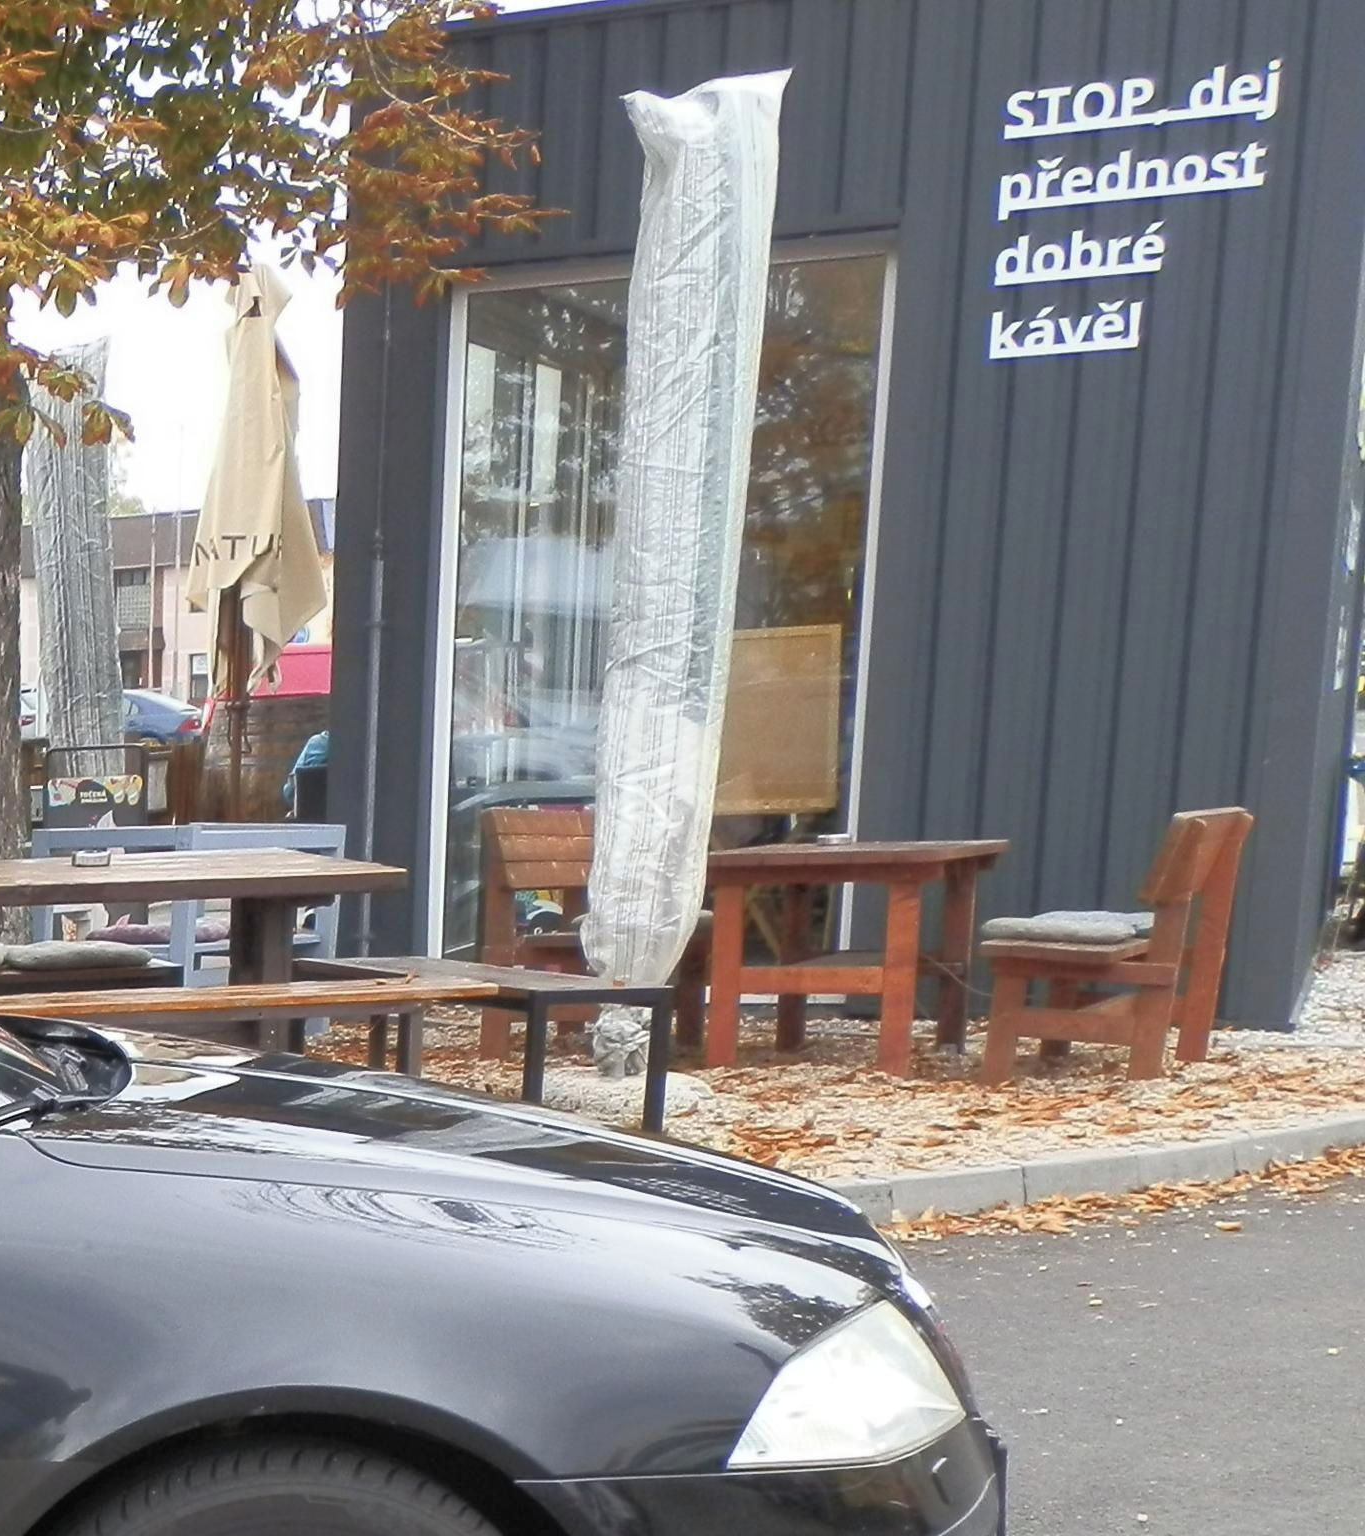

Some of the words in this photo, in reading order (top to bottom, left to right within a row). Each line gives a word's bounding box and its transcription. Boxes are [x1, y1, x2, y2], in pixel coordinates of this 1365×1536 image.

[1188, 59, 1283, 121] dej
[997, 141, 1268, 220] přednost
[994, 221, 1166, 286] dobré
